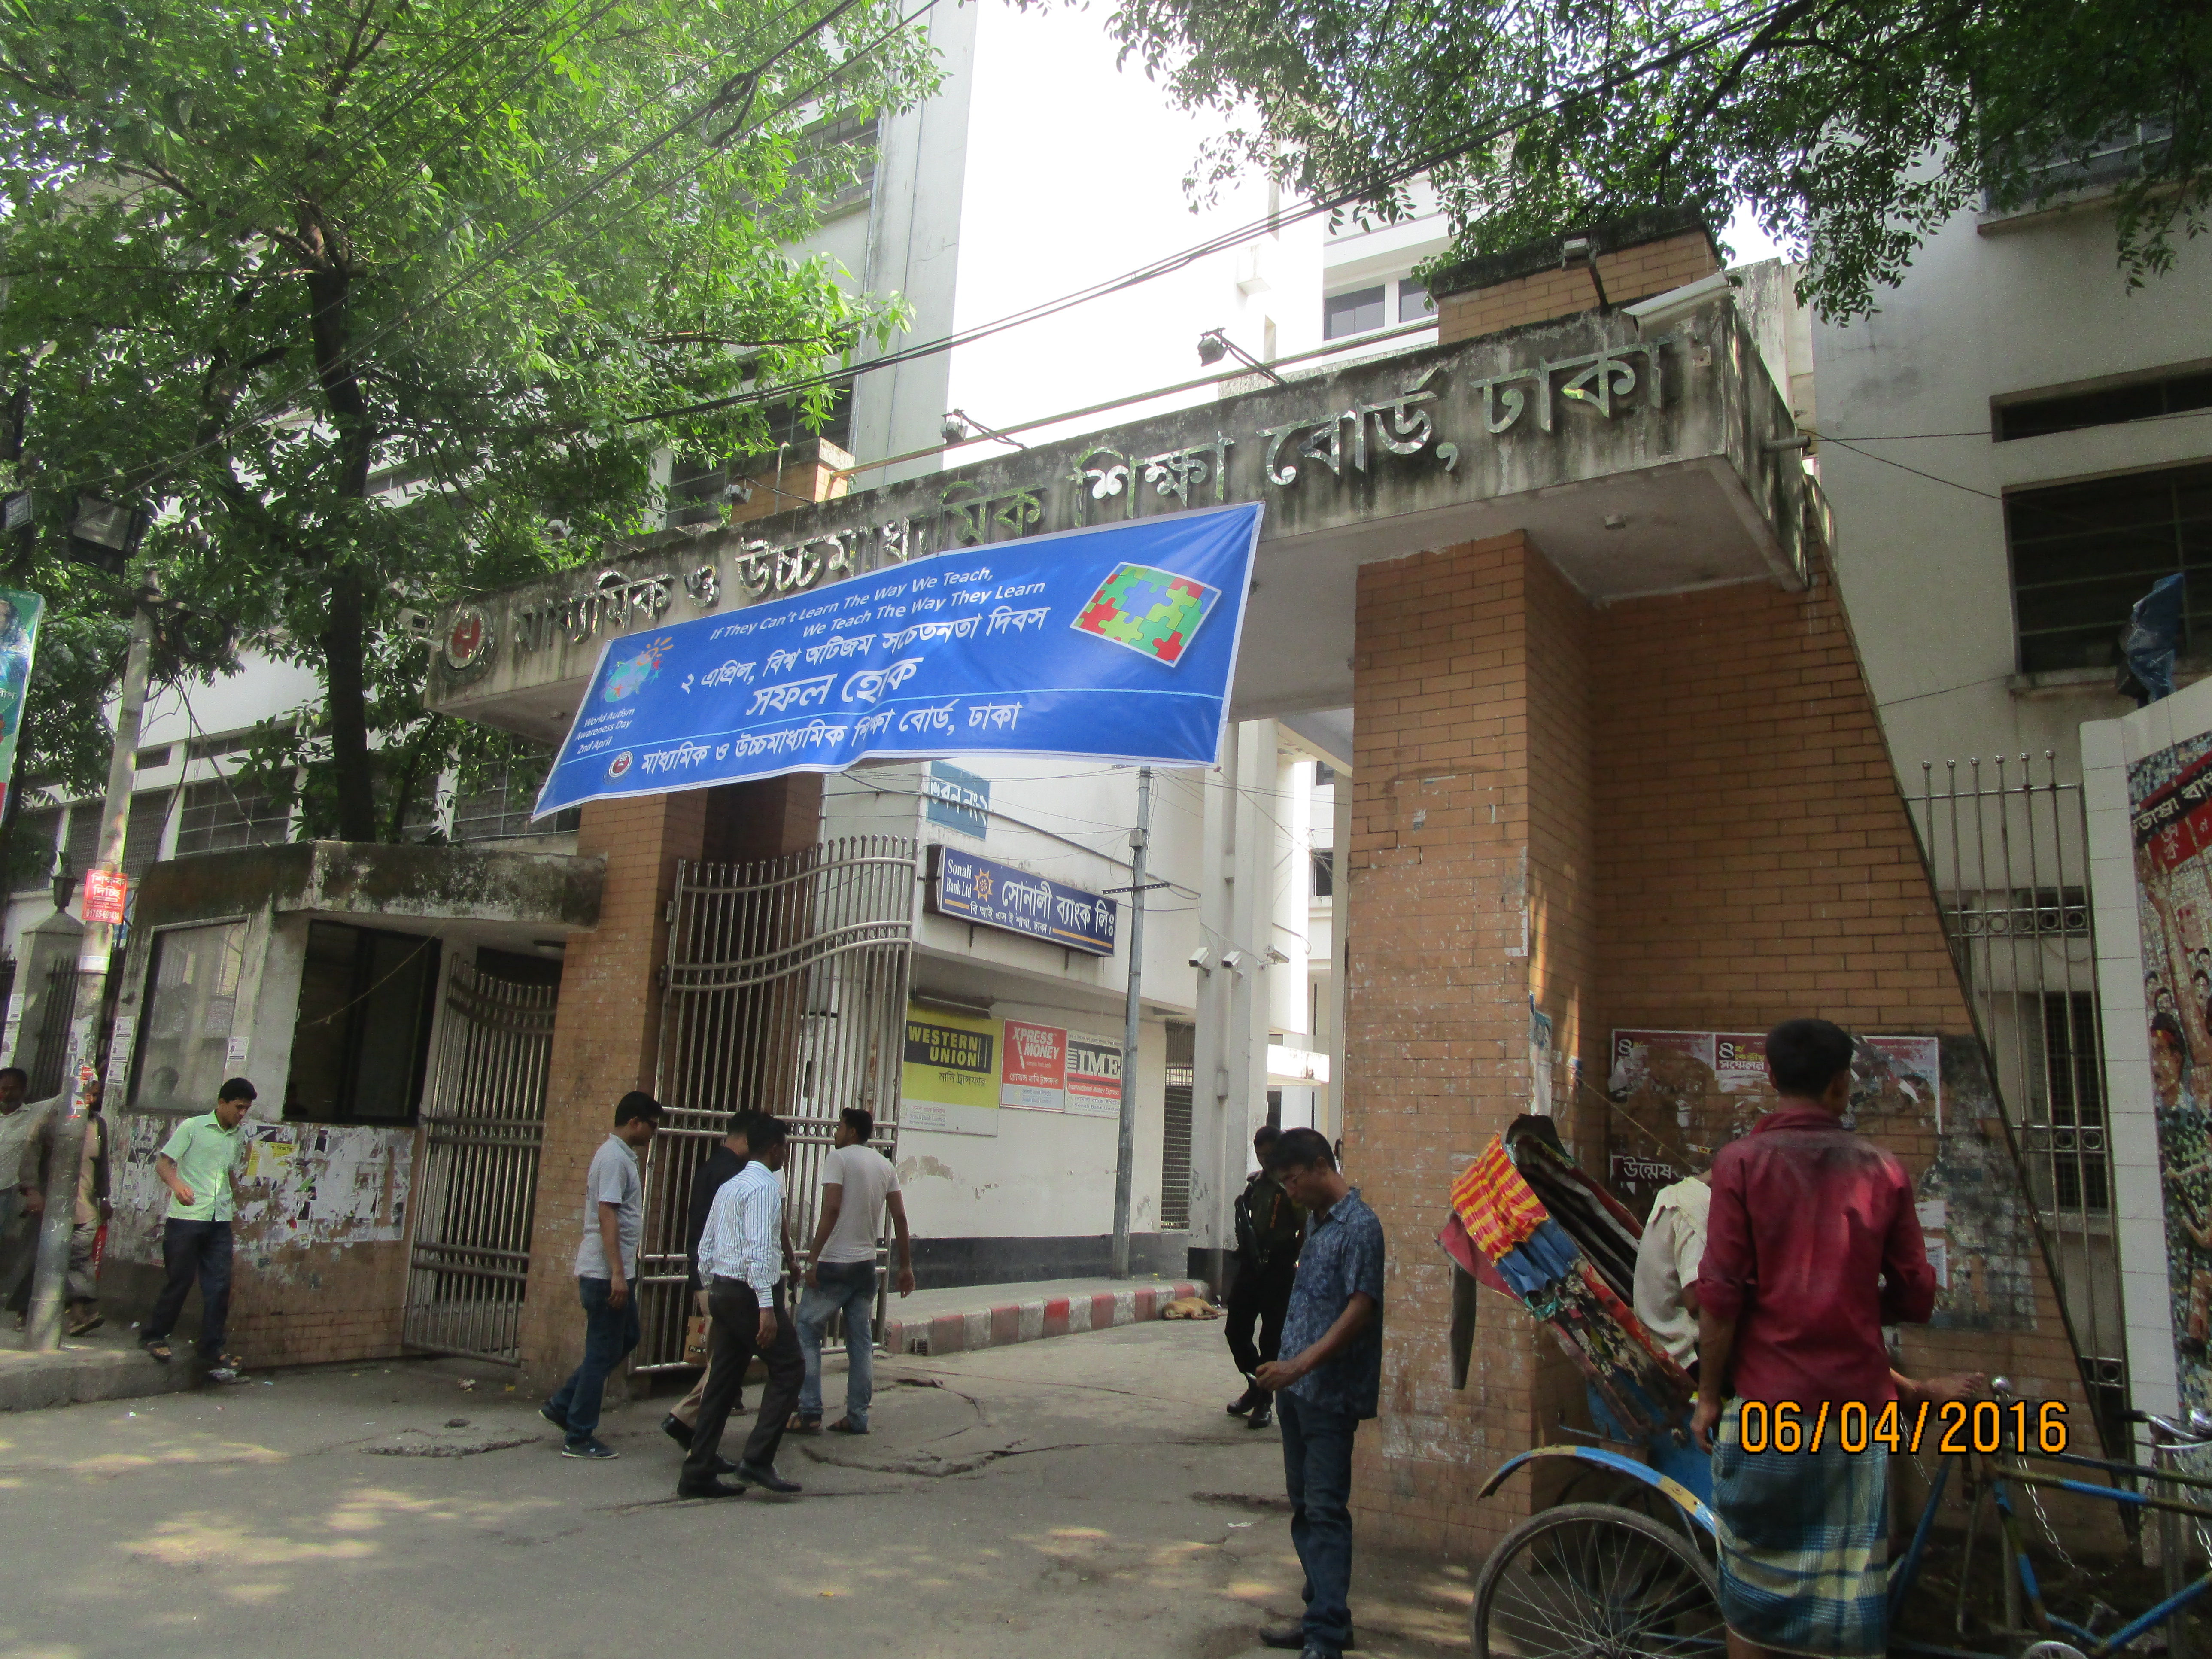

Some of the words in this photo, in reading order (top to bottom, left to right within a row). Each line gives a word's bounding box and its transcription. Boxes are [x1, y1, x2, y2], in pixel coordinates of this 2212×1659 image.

[684, 563, 720, 607] ও
[1069, 431, 1235, 525] শিক্ষা
[1255, 365, 1458, 486] বোর্ড,
[1471, 338, 1669, 434] ঢাকা
[709, 628, 722, 641] If
[724, 620, 758, 639] They
[797, 604, 837, 621] Learn
[844, 594, 869, 612] The
[875, 584, 906, 602] Way
[912, 575, 937, 592] We
[944, 566, 994, 586] Teach,
[802, 623, 827, 639] We
[831, 613, 870, 631] Teach
[877, 603, 907, 620] The
[912, 594, 946, 615] Way
[951, 589, 993, 609] They
[994, 580, 1046, 600] Learn
[681, 677, 693, 694] ২
[700, 659, 757, 688] এপ্রিল,
[763, 647, 802, 677] বিশ্ব
[805, 631, 877, 666] অটিজম
[882, 613, 982, 654] সচেতনতা
[987, 605, 1051, 637] দিবস
[746, 672, 839, 716] সফল
[841, 656, 924, 704] হোক
[584, 714, 607, 728] World
[607, 707, 636, 722] Autism
[574, 725, 614, 742] Awareness
[615, 719, 633, 731] Day
[641, 740, 712, 775] মাধ্যমিক
[715, 742, 730, 761] ও
[735, 718, 848, 758] উচ্চমাধ্যমিক
[851, 708, 897, 747] শিক্ষা
[899, 698, 960, 736] বোর্ড,
[968, 701, 1024, 731] ঢাকা
[577, 743, 592, 755] 2nd
[592, 735, 614, 751] April
[91, 872, 125, 887] শিক্ষক
[947, 858, 972, 879] Sonali
[92, 884, 122, 899] দিচ্ছি
[946, 876, 961, 894] Bank
[961, 881, 972, 899] Ltd
[969, 900, 978, 916] বি
[979, 905, 994, 921] আই
[995, 911, 1007, 923] এস
[1008, 910, 1015, 926] ই
[1001, 880, 1054, 920] সোনালী
[1055, 895, 1092, 931] ব্যাংক
[908, 1025, 978, 1050] WESTERN
[1012, 1027, 1054, 1045] XPRESS
[929, 1046, 977, 1067] UNION
[1024, 1042, 1061, 1060] MONEY
[1076, 1049, 1121, 1079] IME
[939, 1070, 956, 1083] মানি
[1093, 1086, 1105, 1094] Money
[1623, 1155, 1672, 1179] উন্মেষ
